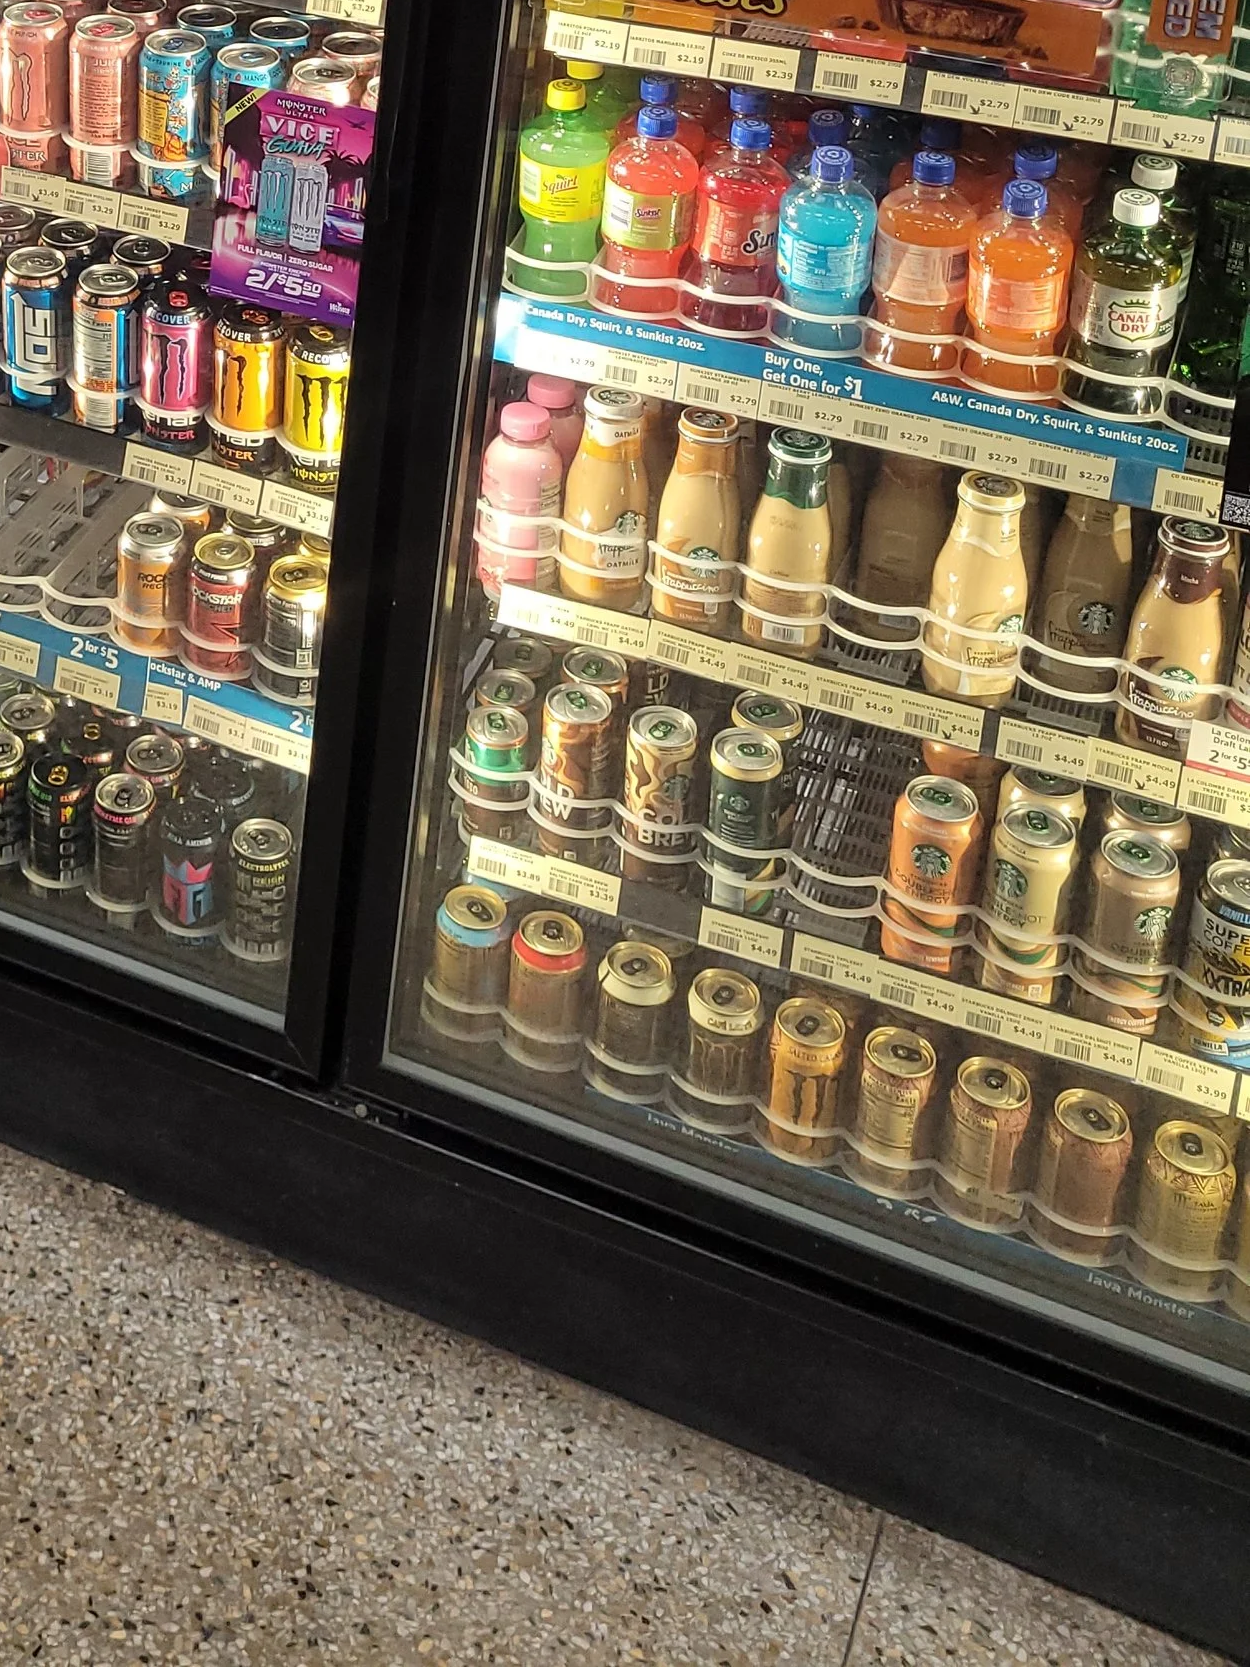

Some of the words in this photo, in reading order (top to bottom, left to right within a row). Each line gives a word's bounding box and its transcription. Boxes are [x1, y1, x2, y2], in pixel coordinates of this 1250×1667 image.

[765, 69, 793, 81] $2.39
[869, 79, 899, 91] $2.79
[236, 93, 257, 113] NEW!
[277, 97, 327, 117] MONSTER
[285, 110, 315, 120] ULTRA
[265, 114, 334, 146] VICE
[266, 135, 326, 160] GUAVA
[541, 174, 578, 194] Squirt
[238, 244, 254, 256] FULL
[256, 248, 283, 261] FLAVOR
[289, 255, 308, 267] ZERO
[309, 260, 334, 273] SUGAR
[566, 311, 588, 329] Dry,
[590, 317, 622, 336] Squirt,
[625, 325, 633, 336] &
[636, 327, 674, 346] Sunkist
[677, 335, 706, 352] 20oz.
[1120, 322, 1148, 333] DRY
[764, 351, 790, 368] Buy
[793, 357, 823, 376] One,
[763, 368, 786, 383] Get
[790, 374, 818, 391] One
[821, 379, 841, 395] for
[844, 375, 863, 400] $1
[931, 390, 964, 409] A&W,
[967, 397, 1011, 417] Canada
[1016, 408, 1039, 425] Dry,
[1042, 414, 1081, 434] Squirt,
[1084, 421, 1094, 435] &
[1098, 426, 1143, 446] Sunkist
[1146, 436, 1179, 453] 20oz.
[70, 636, 84, 659] 2
[84, 639, 99, 653] for
[100, 646, 119, 669] $5
[782, 677, 809, 692] $4.49
[1125, 1283, 1196, 1321] Monster
